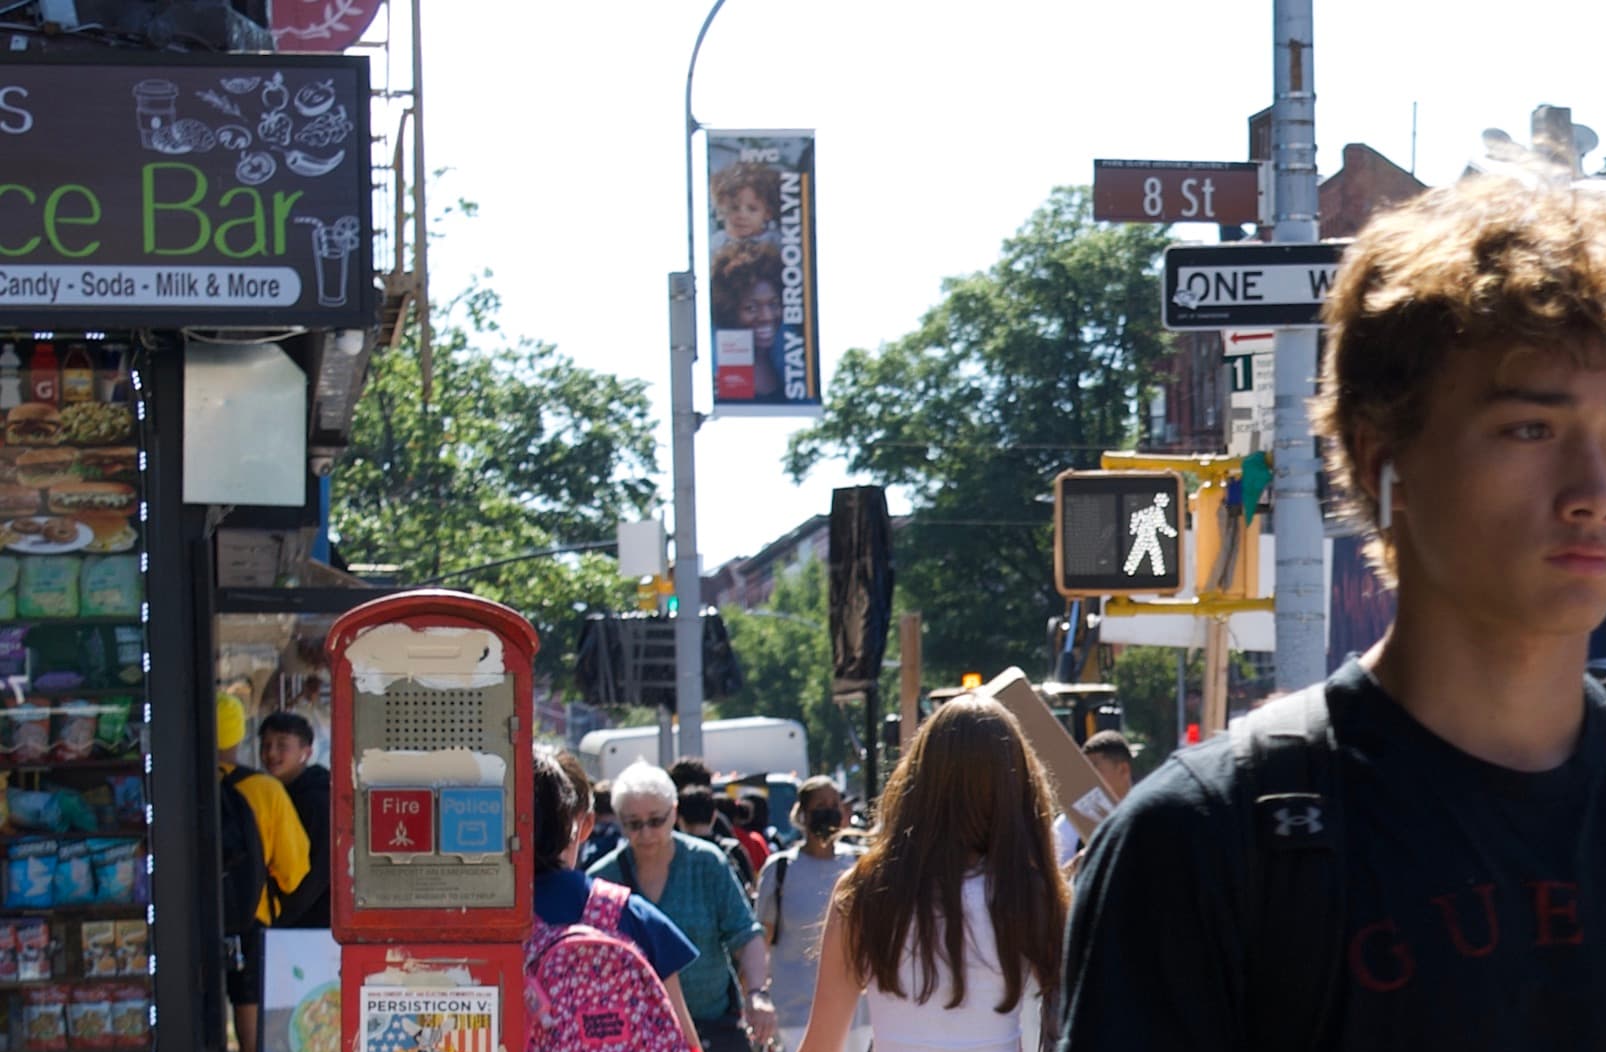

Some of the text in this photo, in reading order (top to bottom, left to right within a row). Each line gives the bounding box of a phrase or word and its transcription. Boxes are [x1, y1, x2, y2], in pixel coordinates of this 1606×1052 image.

[142, 161, 304, 259] Bar
[1143, 177, 1216, 217] 8 St
[81, 271, 136, 295] Soda
[156, 274, 200, 297] Milk
[205, 275, 221, 297] &
[227, 275, 281, 298] More
[780, 172, 805, 399] STAY BROOKLYN
[1185, 271, 1264, 300] ONE
[383, 797, 420, 814] Fire
[444, 798, 500, 814] Police
[367, 1000, 472, 1012] PERSISTICON
